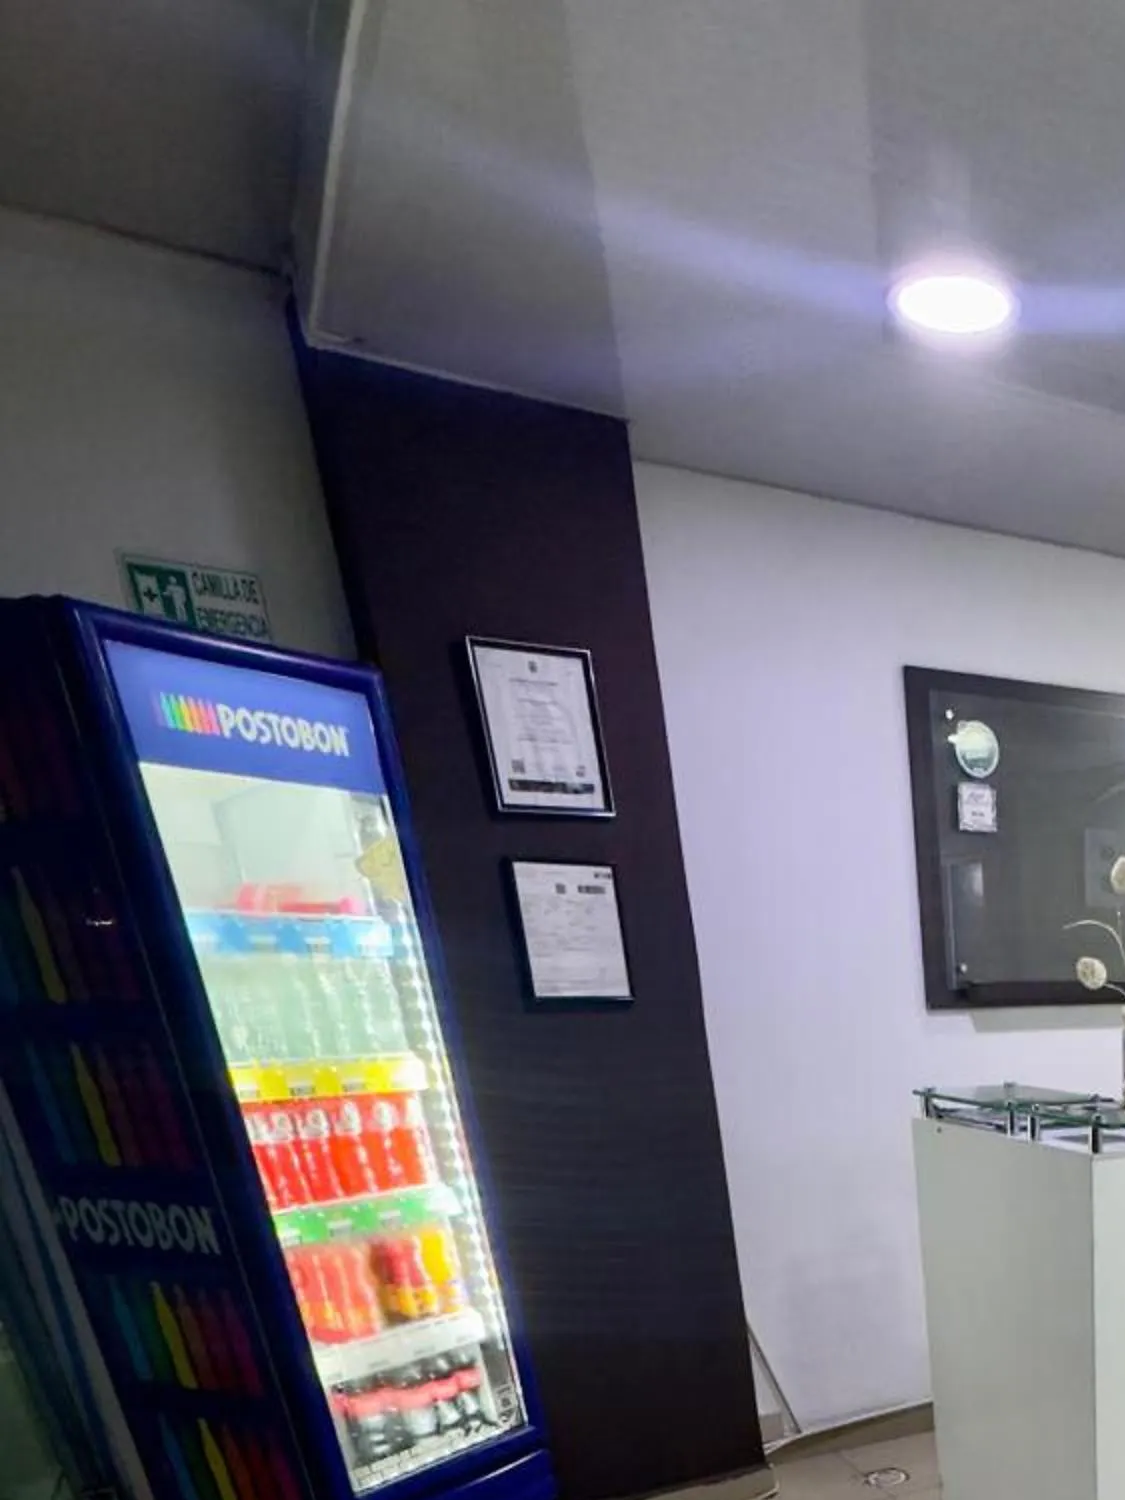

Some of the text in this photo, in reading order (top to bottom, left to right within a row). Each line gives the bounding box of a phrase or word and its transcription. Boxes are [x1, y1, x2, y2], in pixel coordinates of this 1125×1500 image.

[241, 578, 260, 606] DE
[215, 703, 350, 758] POSTOBON
[58, 1195, 222, 1256] POSTOBON
